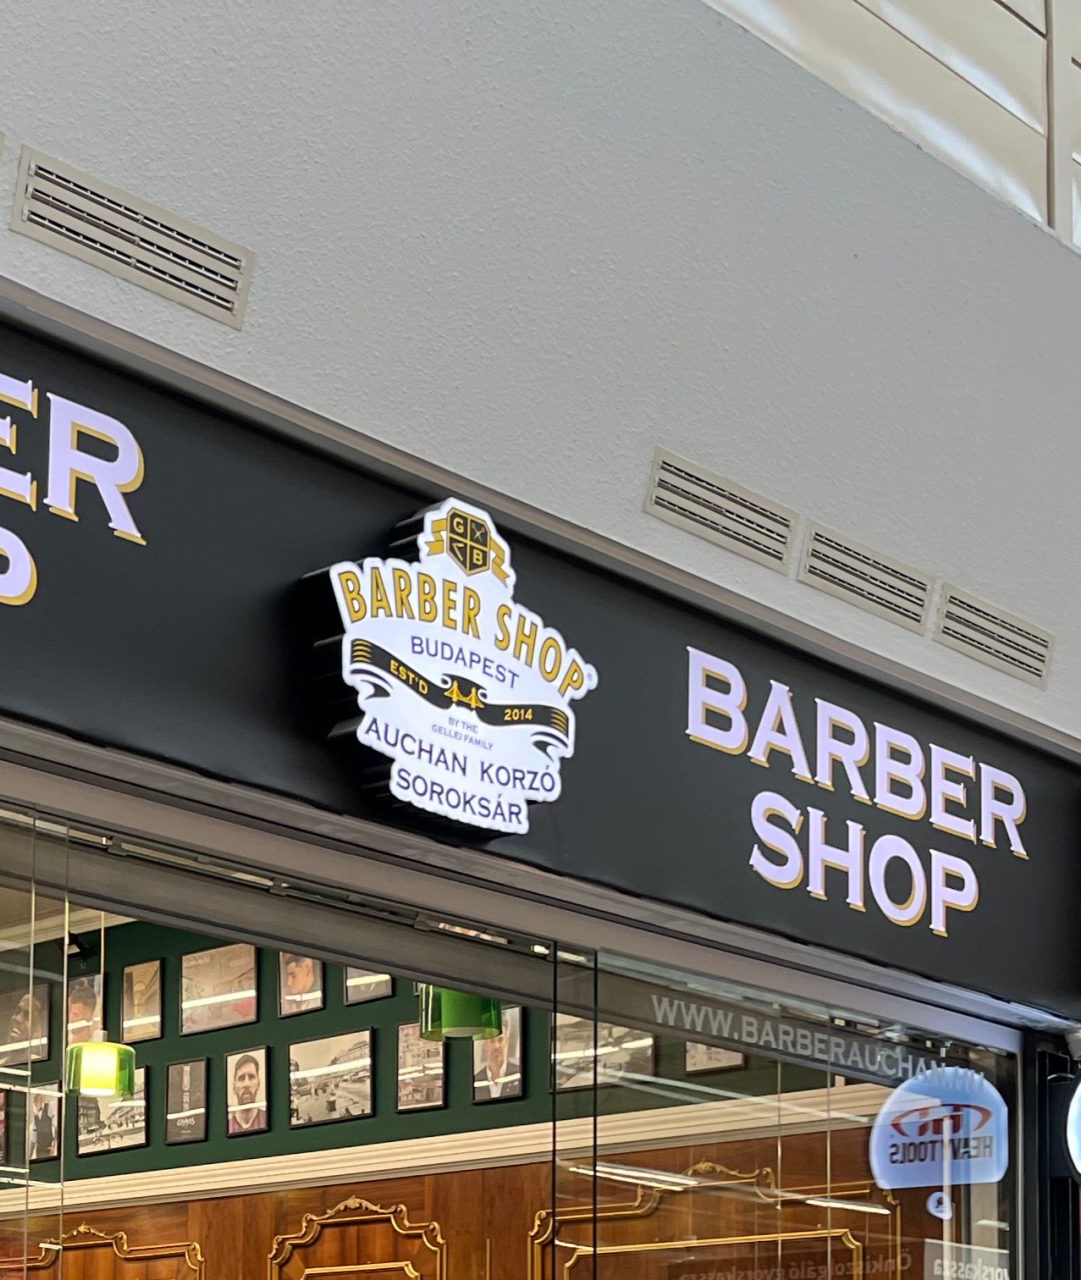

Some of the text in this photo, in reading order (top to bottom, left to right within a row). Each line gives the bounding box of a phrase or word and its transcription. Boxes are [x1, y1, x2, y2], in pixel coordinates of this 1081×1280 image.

[453, 518, 464, 533] G
[473, 551, 483, 565] B
[338, 566, 585, 698] BARBER SHOP
[389, 660, 533, 720] EST'D 2014
[411, 636, 519, 689] BUDAPEST
[448, 717, 478, 733] BY THE
[464, 735, 493, 751] FAMILY
[685, 646, 1029, 860] BARBER
[365, 717, 555, 792] AUCHAN KORZÓ
[397, 768, 522, 824] SOROKSÁR
[749, 791, 979, 937] SHOP
